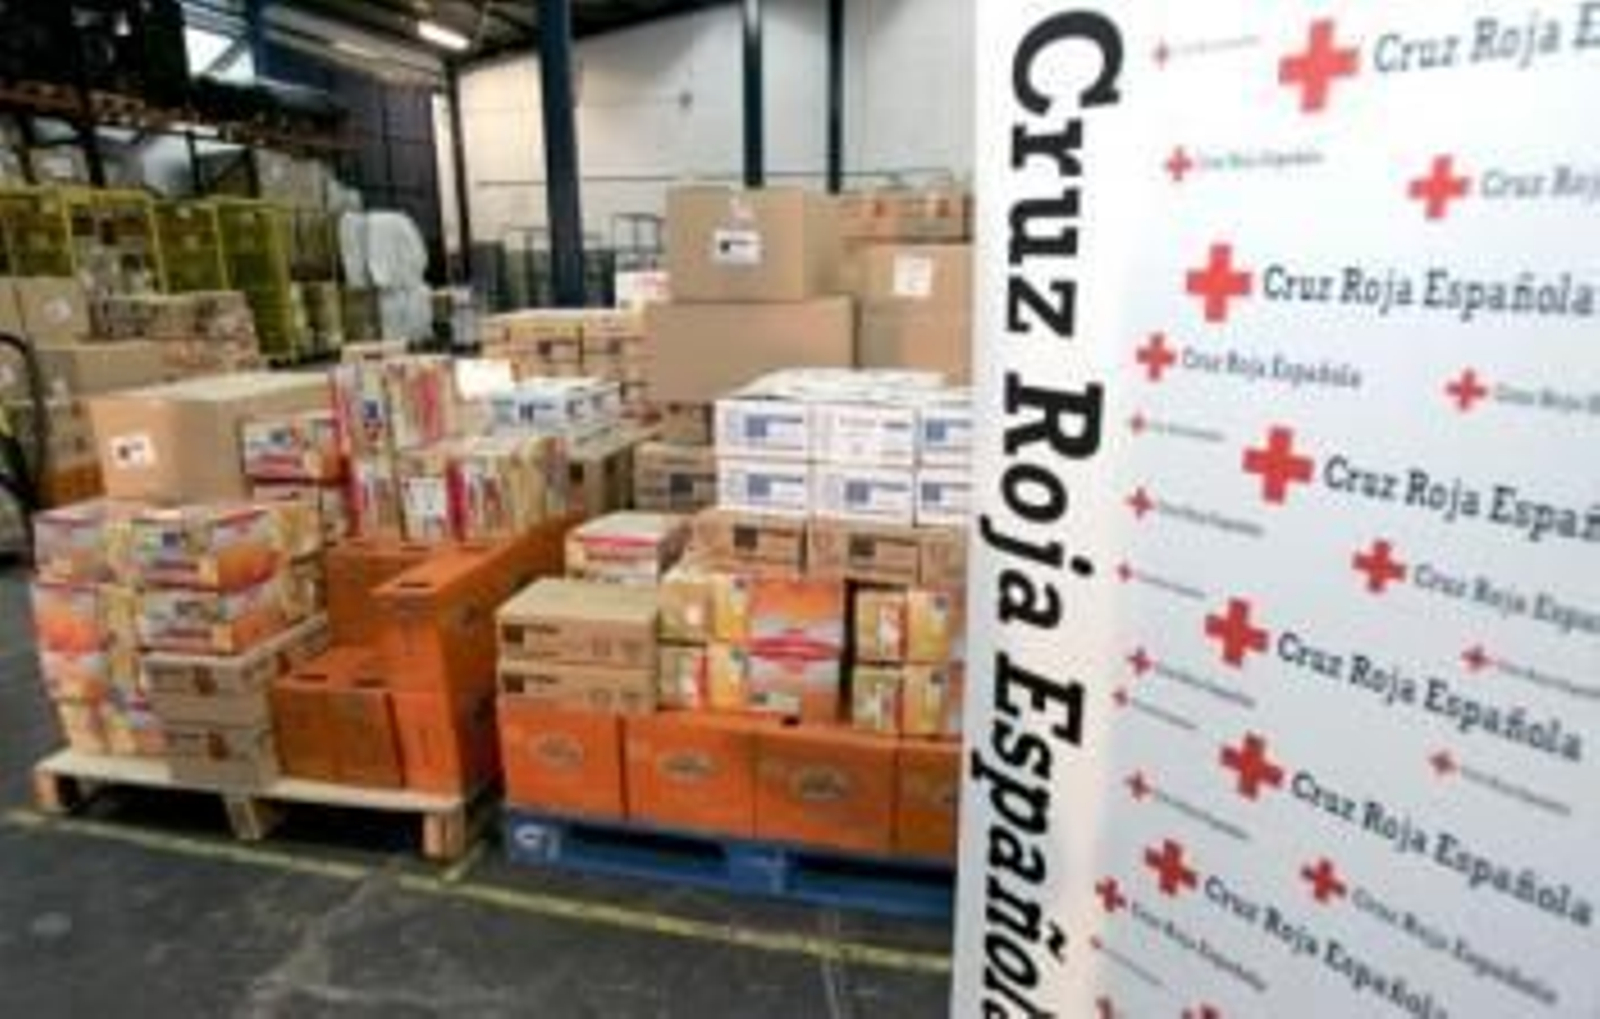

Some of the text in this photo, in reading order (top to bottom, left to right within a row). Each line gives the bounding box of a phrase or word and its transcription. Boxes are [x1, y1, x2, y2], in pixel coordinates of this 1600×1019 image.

[1374, 33, 1460, 72] Cruz
[1469, 7, 1561, 71] Roja
[1007, 10, 1123, 337] Cruz
[1264, 264, 1594, 321] Cruz Roja Española
[980, 372, 1104, 629] Roja
[1324, 455, 1398, 500] Cruz
[1405, 469, 1480, 522] Roja
[1277, 632, 1581, 761] Cruz Roja Española
[1292, 773, 1356, 820] Cruz
[1363, 801, 1427, 853] Roja
[1434, 832, 1593, 926] Española
[1205, 876, 1258, 924] Cruz
[1264, 906, 1318, 955] Roja
